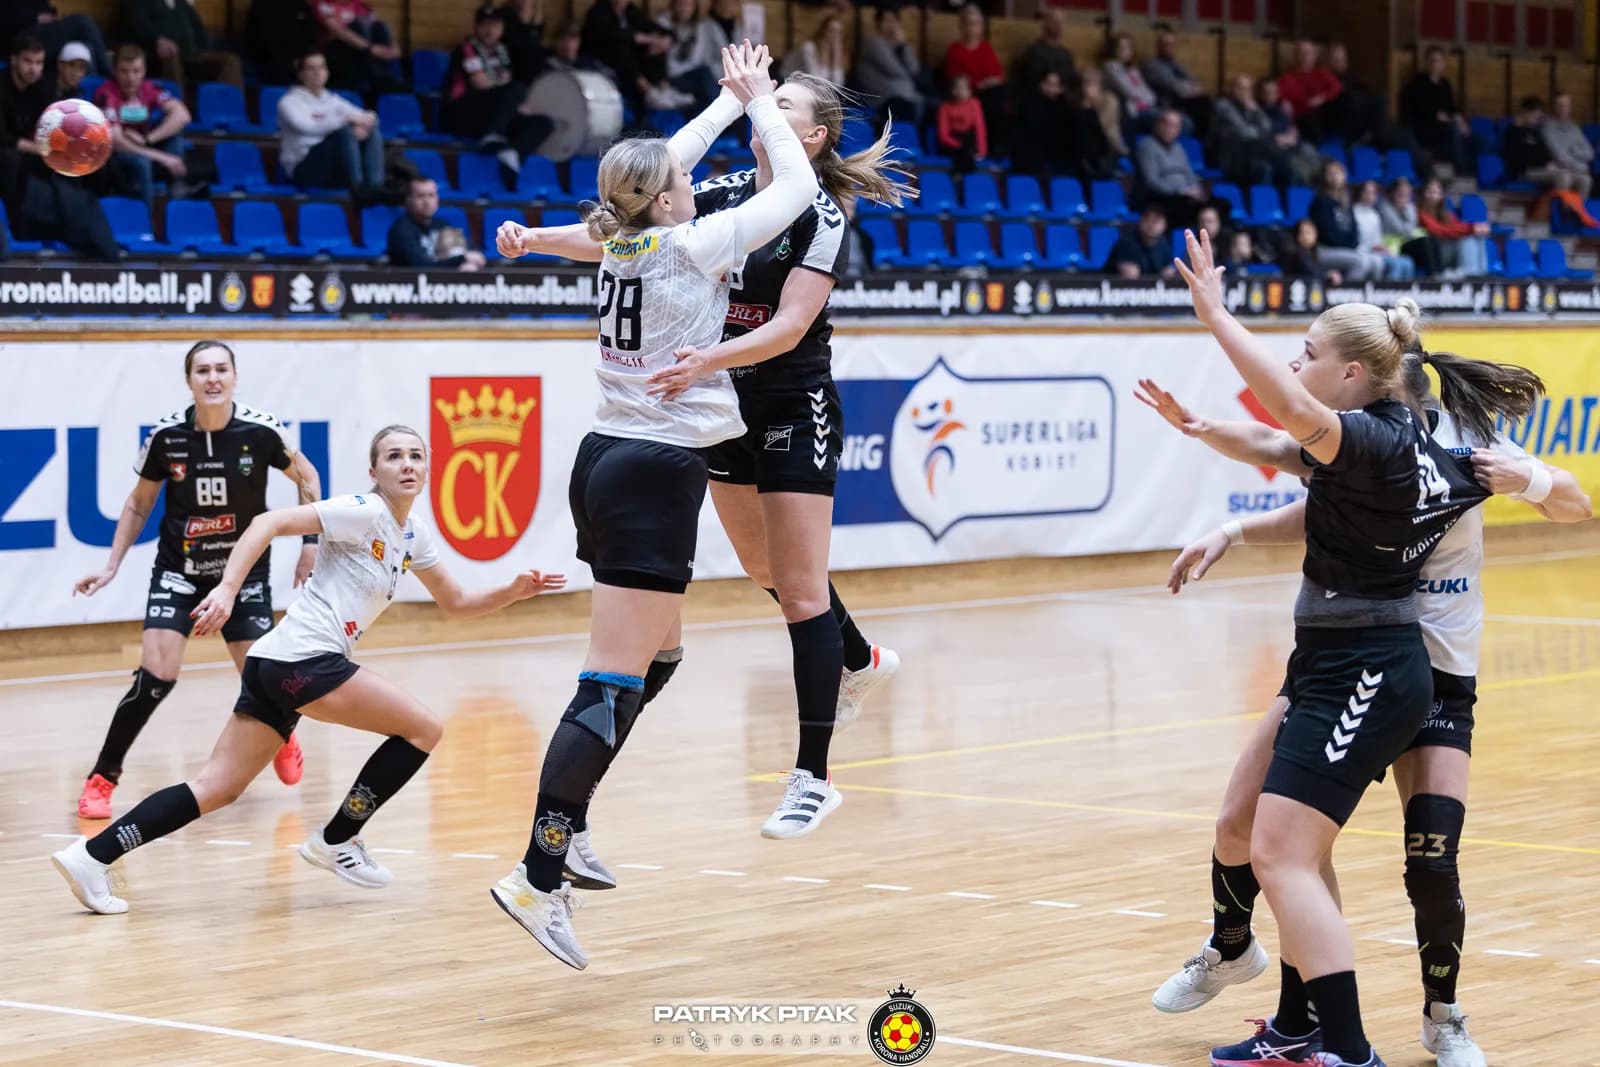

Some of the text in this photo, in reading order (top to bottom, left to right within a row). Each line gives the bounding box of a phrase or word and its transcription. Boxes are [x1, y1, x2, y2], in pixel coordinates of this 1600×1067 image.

[0, 272, 211, 312] ronahandball.pl
[352, 274, 598, 304] www.koronahandball.
[601, 269, 643, 350] 28
[981, 420, 1098, 444] SUPERLIGA
[1007, 454, 1077, 472] KOBIET
[196, 477, 227, 506] 89
[439, 449, 520, 541] CK
[189, 518, 232, 533] PERŁA
[1416, 577, 1468, 594] ZUKI
[1407, 833, 1448, 857] 23
